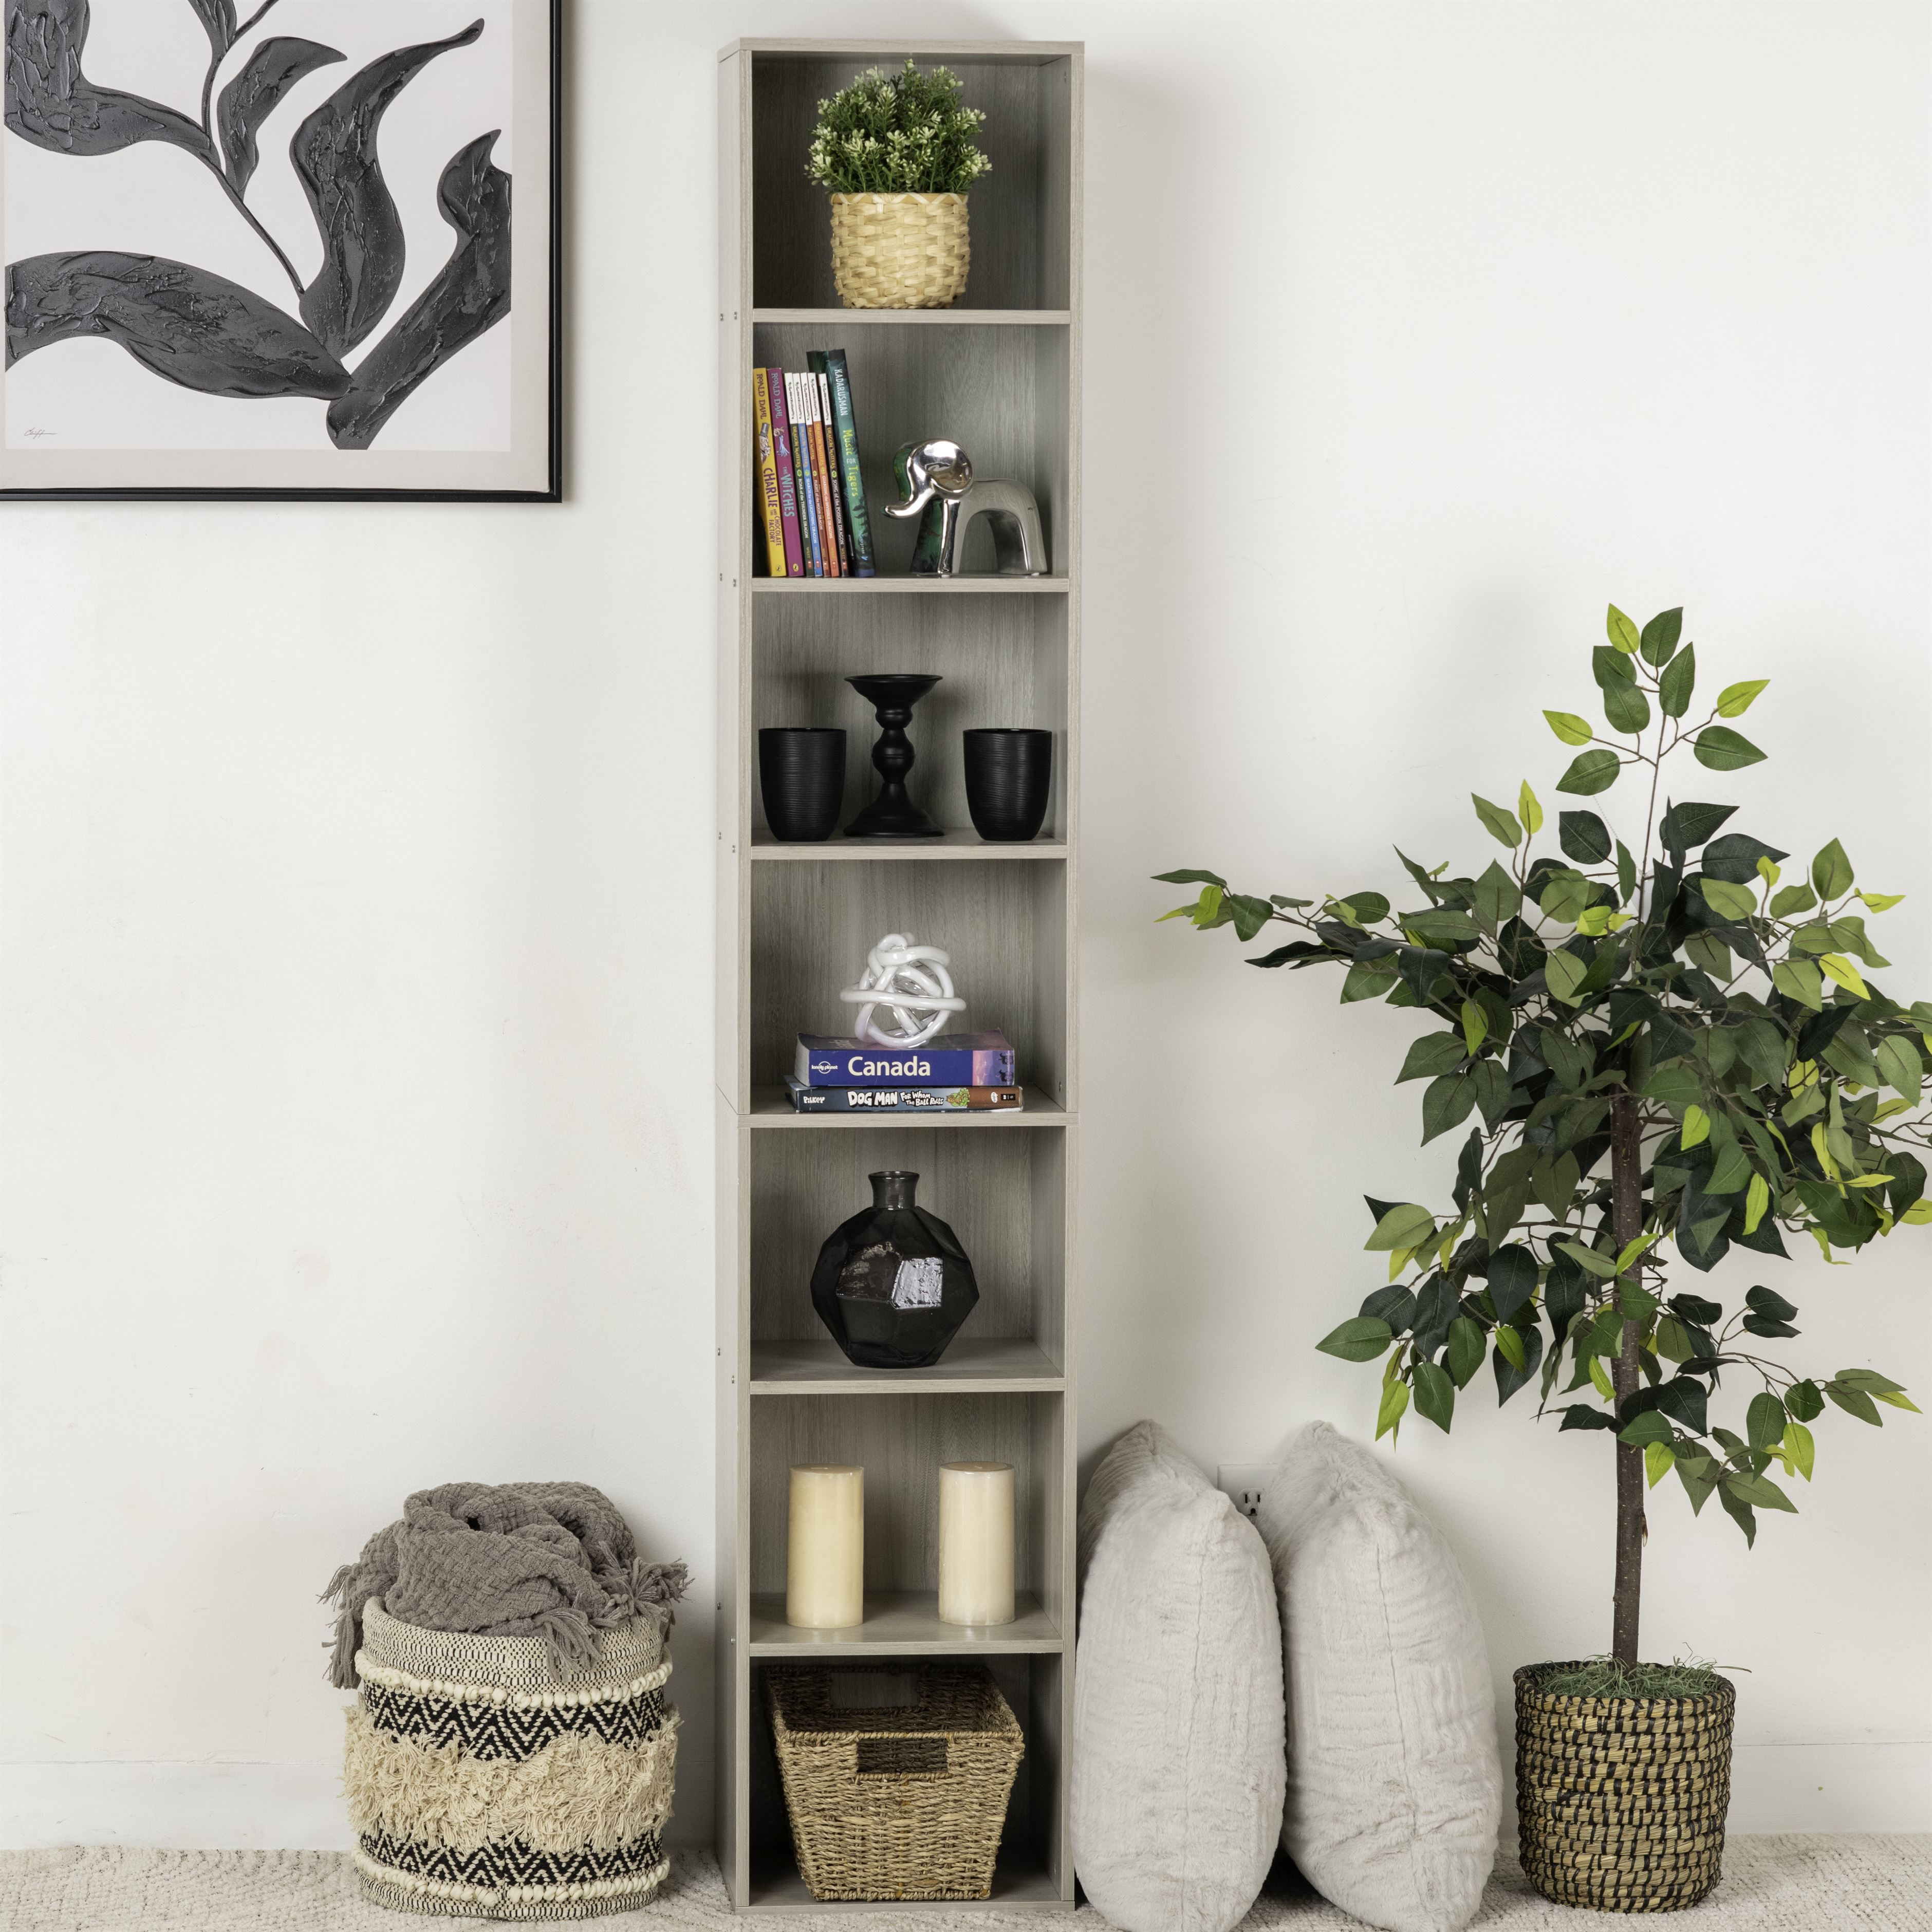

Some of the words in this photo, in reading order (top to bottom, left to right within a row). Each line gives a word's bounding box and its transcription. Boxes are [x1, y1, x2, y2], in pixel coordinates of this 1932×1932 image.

[756, 374, 765, 397] ROALD
[771, 373, 780, 396] ROALD
[834, 369, 848, 416] KADARUSMAN
[843, 429, 854, 455] Music
[763, 468, 777, 508] CHARLIE
[847, 465, 859, 497] Tigers
[781, 474, 795, 517] WITCHES
[848, 1055, 931, 1076] Canada
[847, 1091, 872, 1106] DOG
[874, 1091, 898, 1106] MAN
